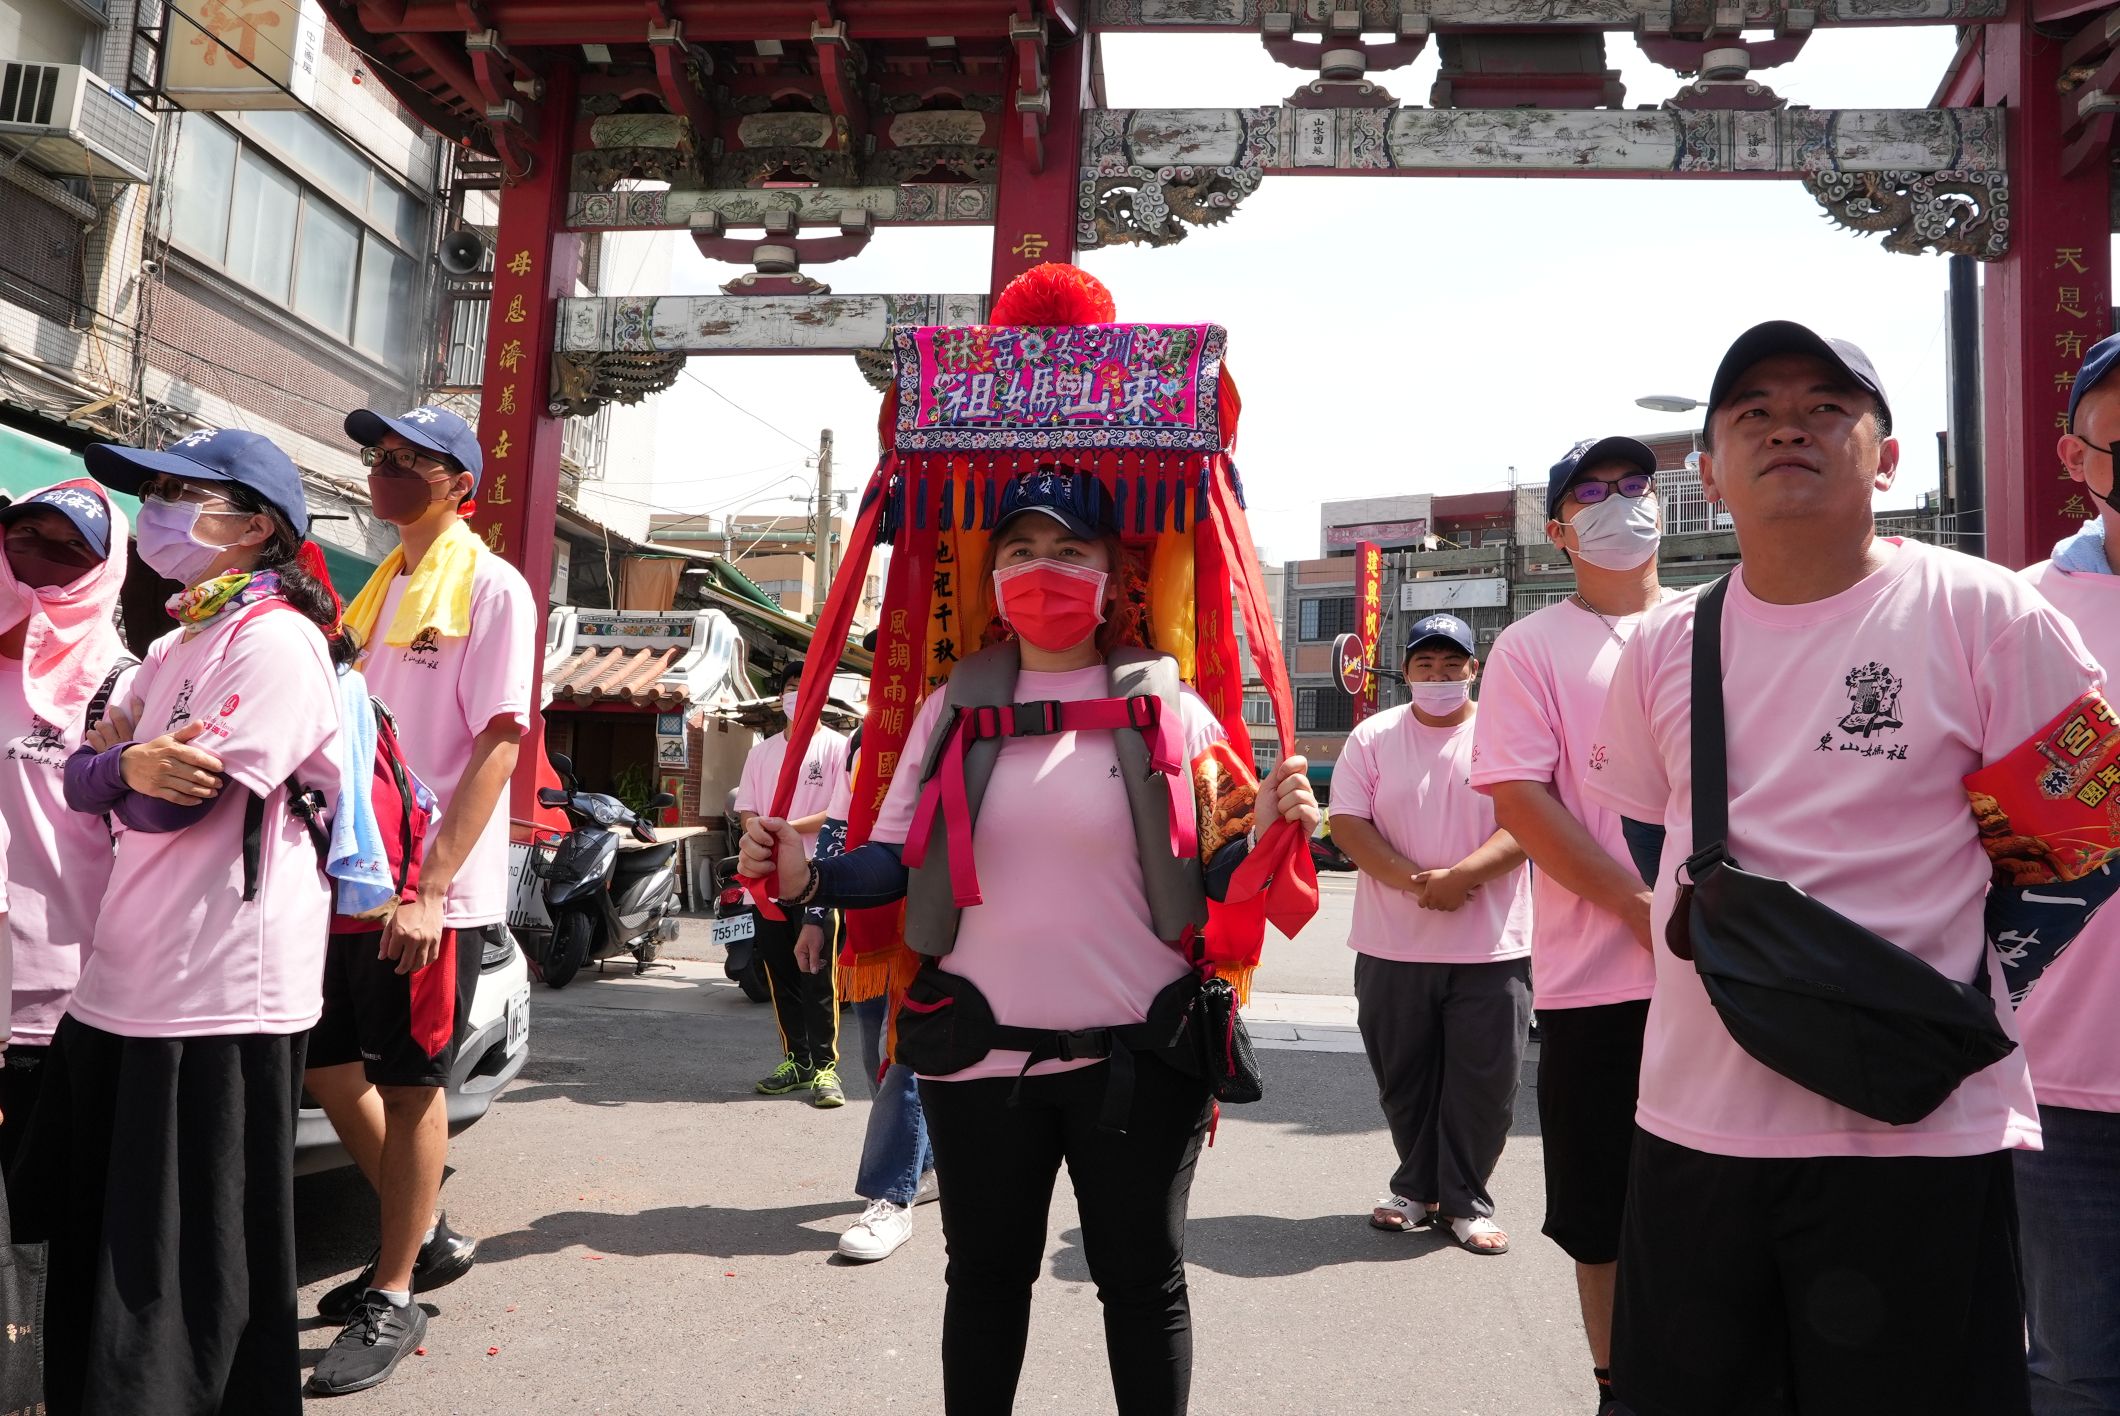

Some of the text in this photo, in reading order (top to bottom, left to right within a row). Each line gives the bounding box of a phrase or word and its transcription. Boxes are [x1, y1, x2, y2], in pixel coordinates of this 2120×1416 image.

[879, 609, 911, 736] 風調雨順
[1814, 731, 1908, 760] 東山媽祖
